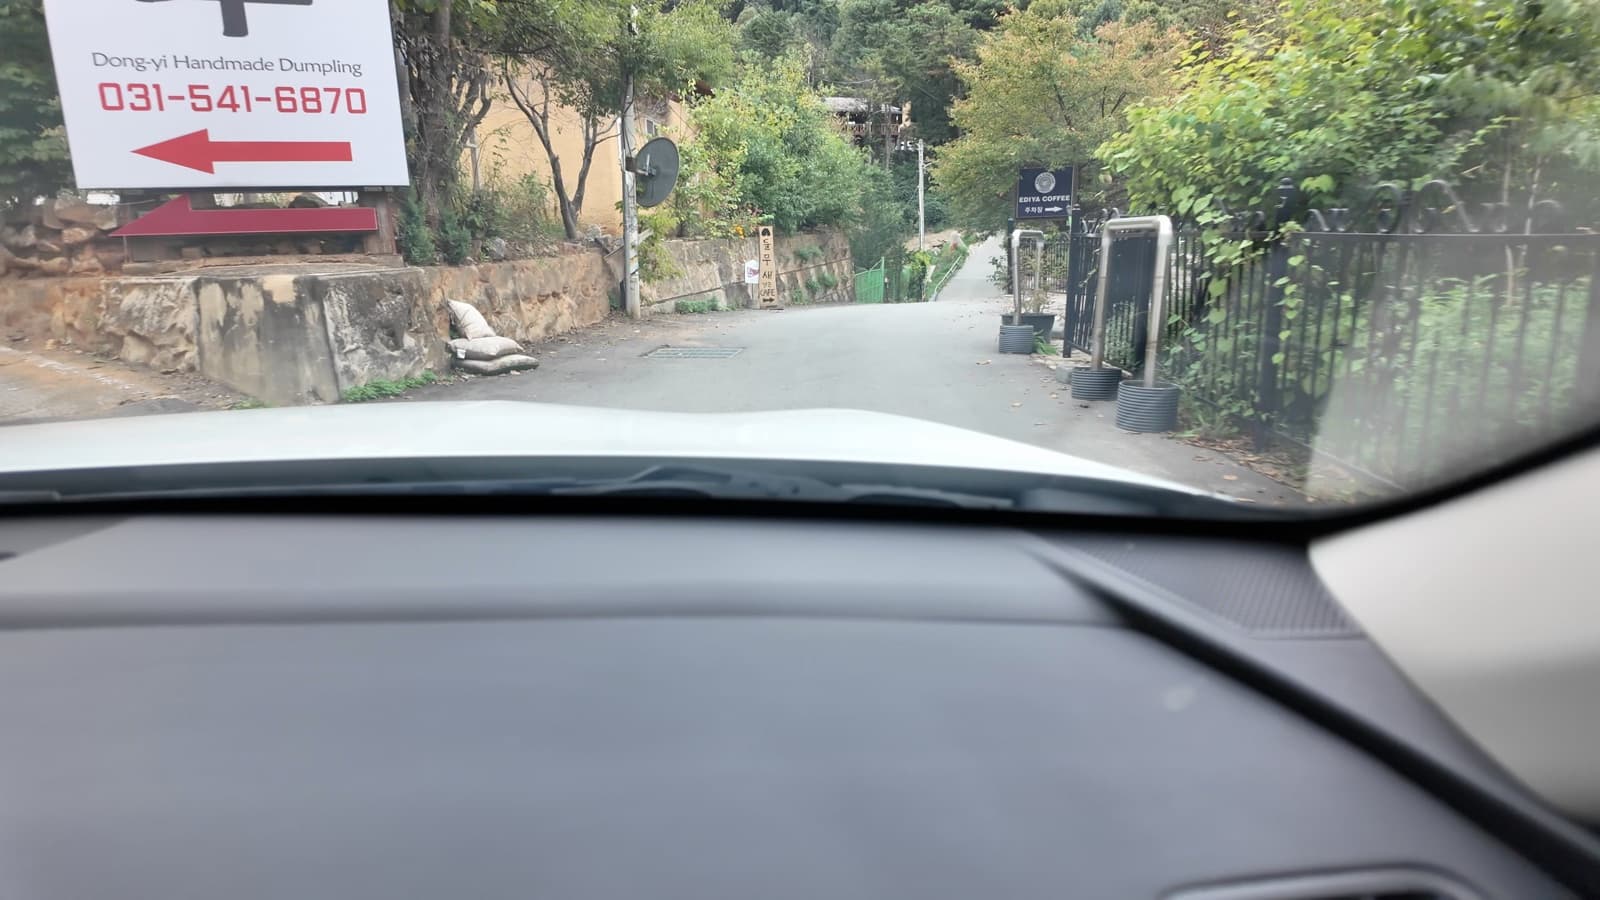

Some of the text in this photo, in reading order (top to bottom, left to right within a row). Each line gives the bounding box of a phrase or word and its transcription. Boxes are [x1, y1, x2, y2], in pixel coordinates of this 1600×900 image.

[91, 52, 363, 77] Dong-yi Handmade Dumpling
[98, 82, 367, 114] 031-541-6870
[1025, 206, 1043, 214] 주차장
[760, 288, 776, 297] CAFE
